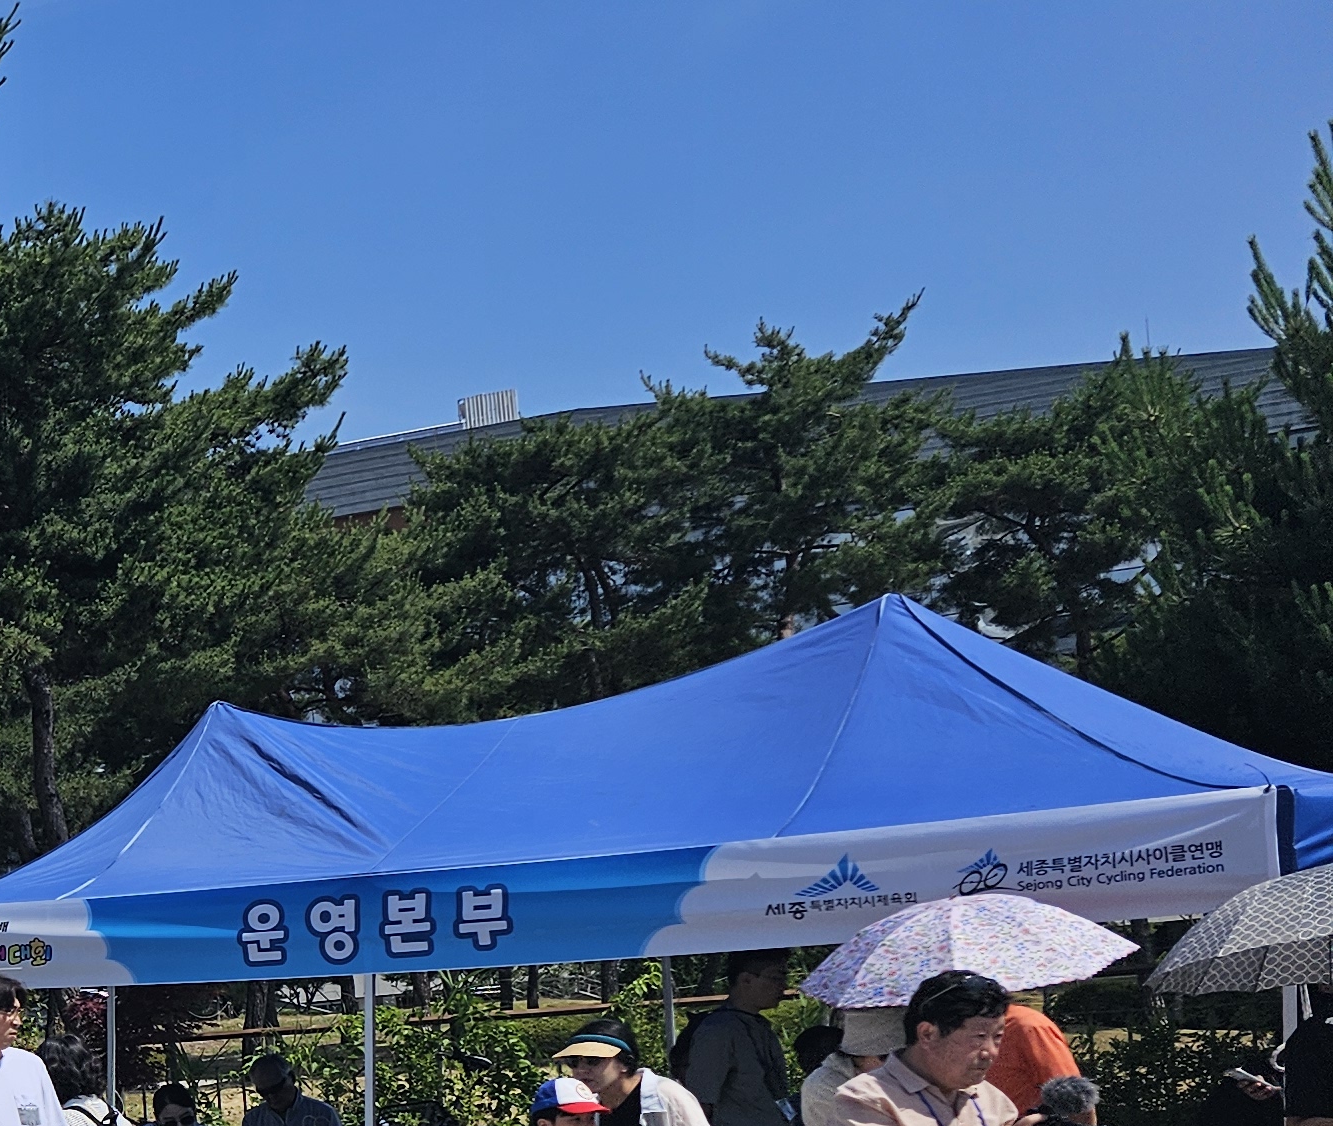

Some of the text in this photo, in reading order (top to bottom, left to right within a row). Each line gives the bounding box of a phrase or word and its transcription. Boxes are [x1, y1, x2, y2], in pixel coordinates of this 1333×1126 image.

[1017, 862, 1225, 892] Sejong City Cycling Federation
[240, 886, 511, 964] 운영본부
